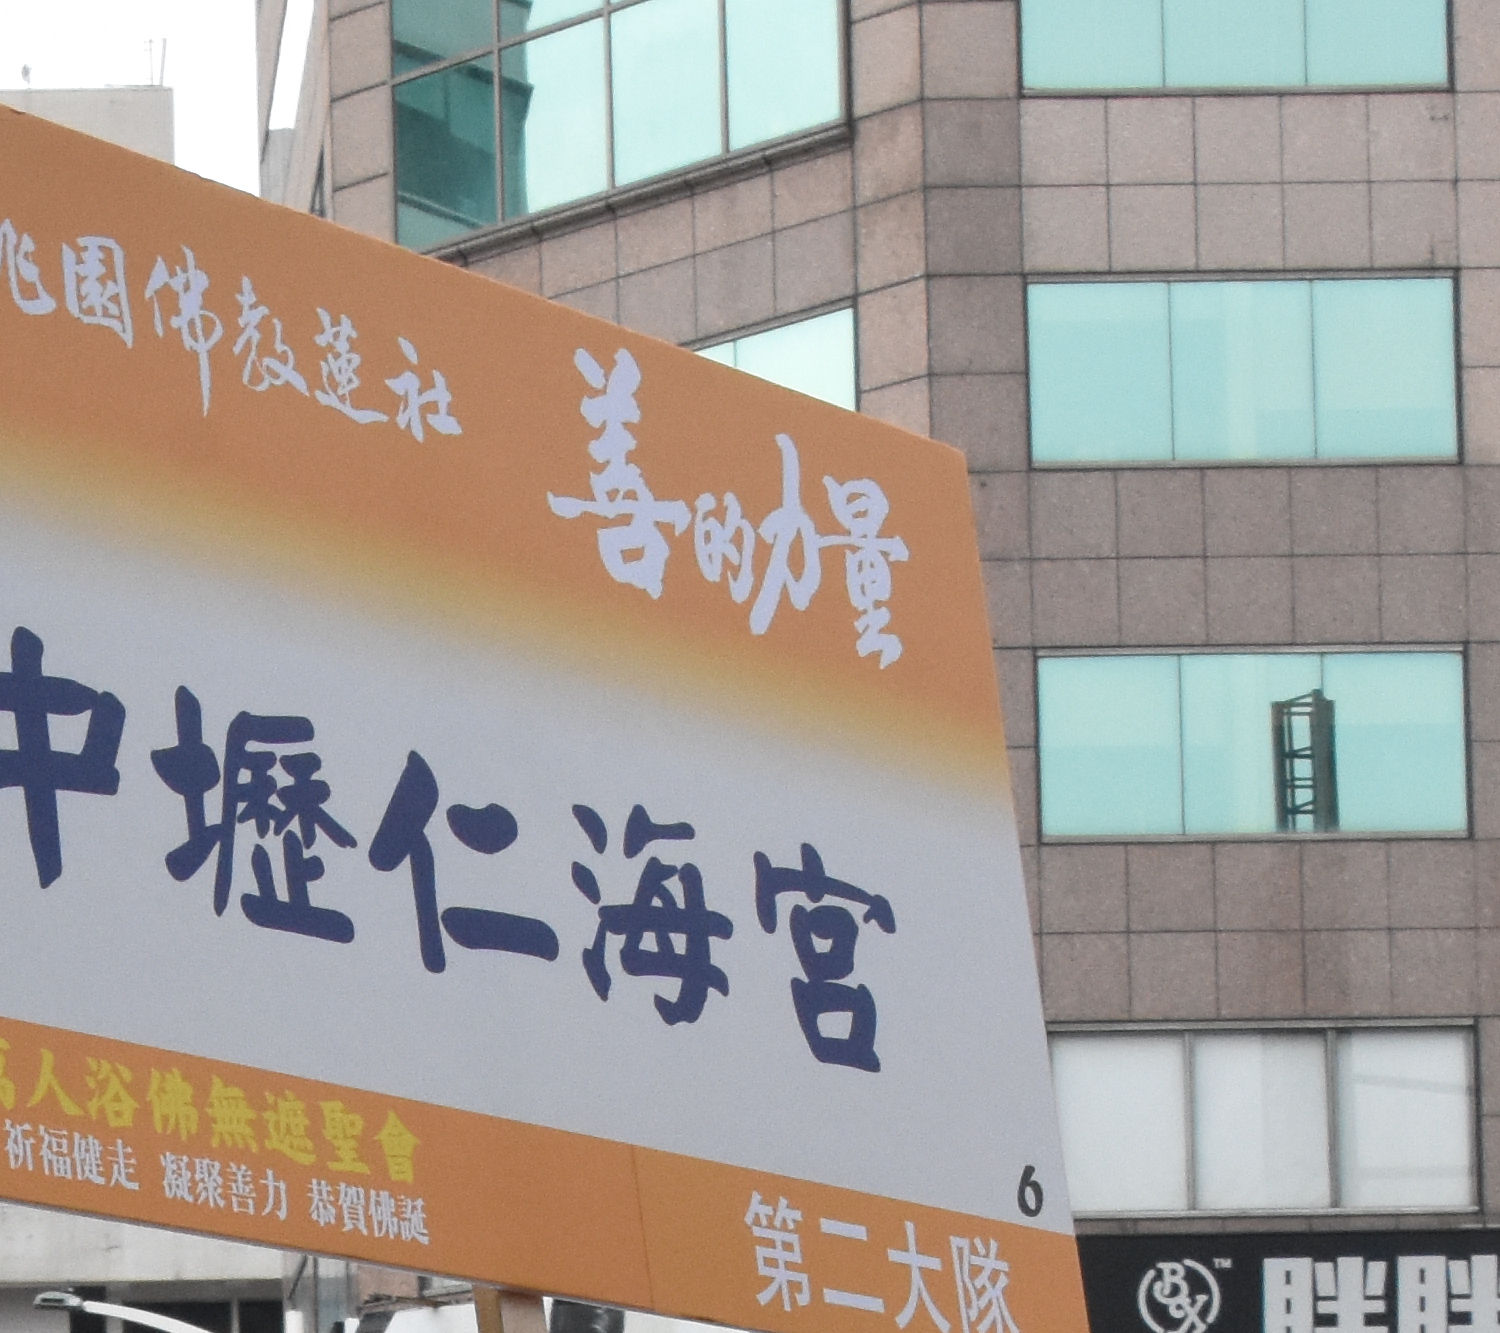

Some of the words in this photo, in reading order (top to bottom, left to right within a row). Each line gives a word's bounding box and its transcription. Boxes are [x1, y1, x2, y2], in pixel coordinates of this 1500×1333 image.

[547, 347, 909, 671] 善的力量
[4, 1119, 140, 1192] 祈福健走
[161, 1151, 288, 1221] 凝聚善力
[307, 1178, 431, 1245] 恭賀佛誕
[1017, 1164, 1044, 1217] 6
